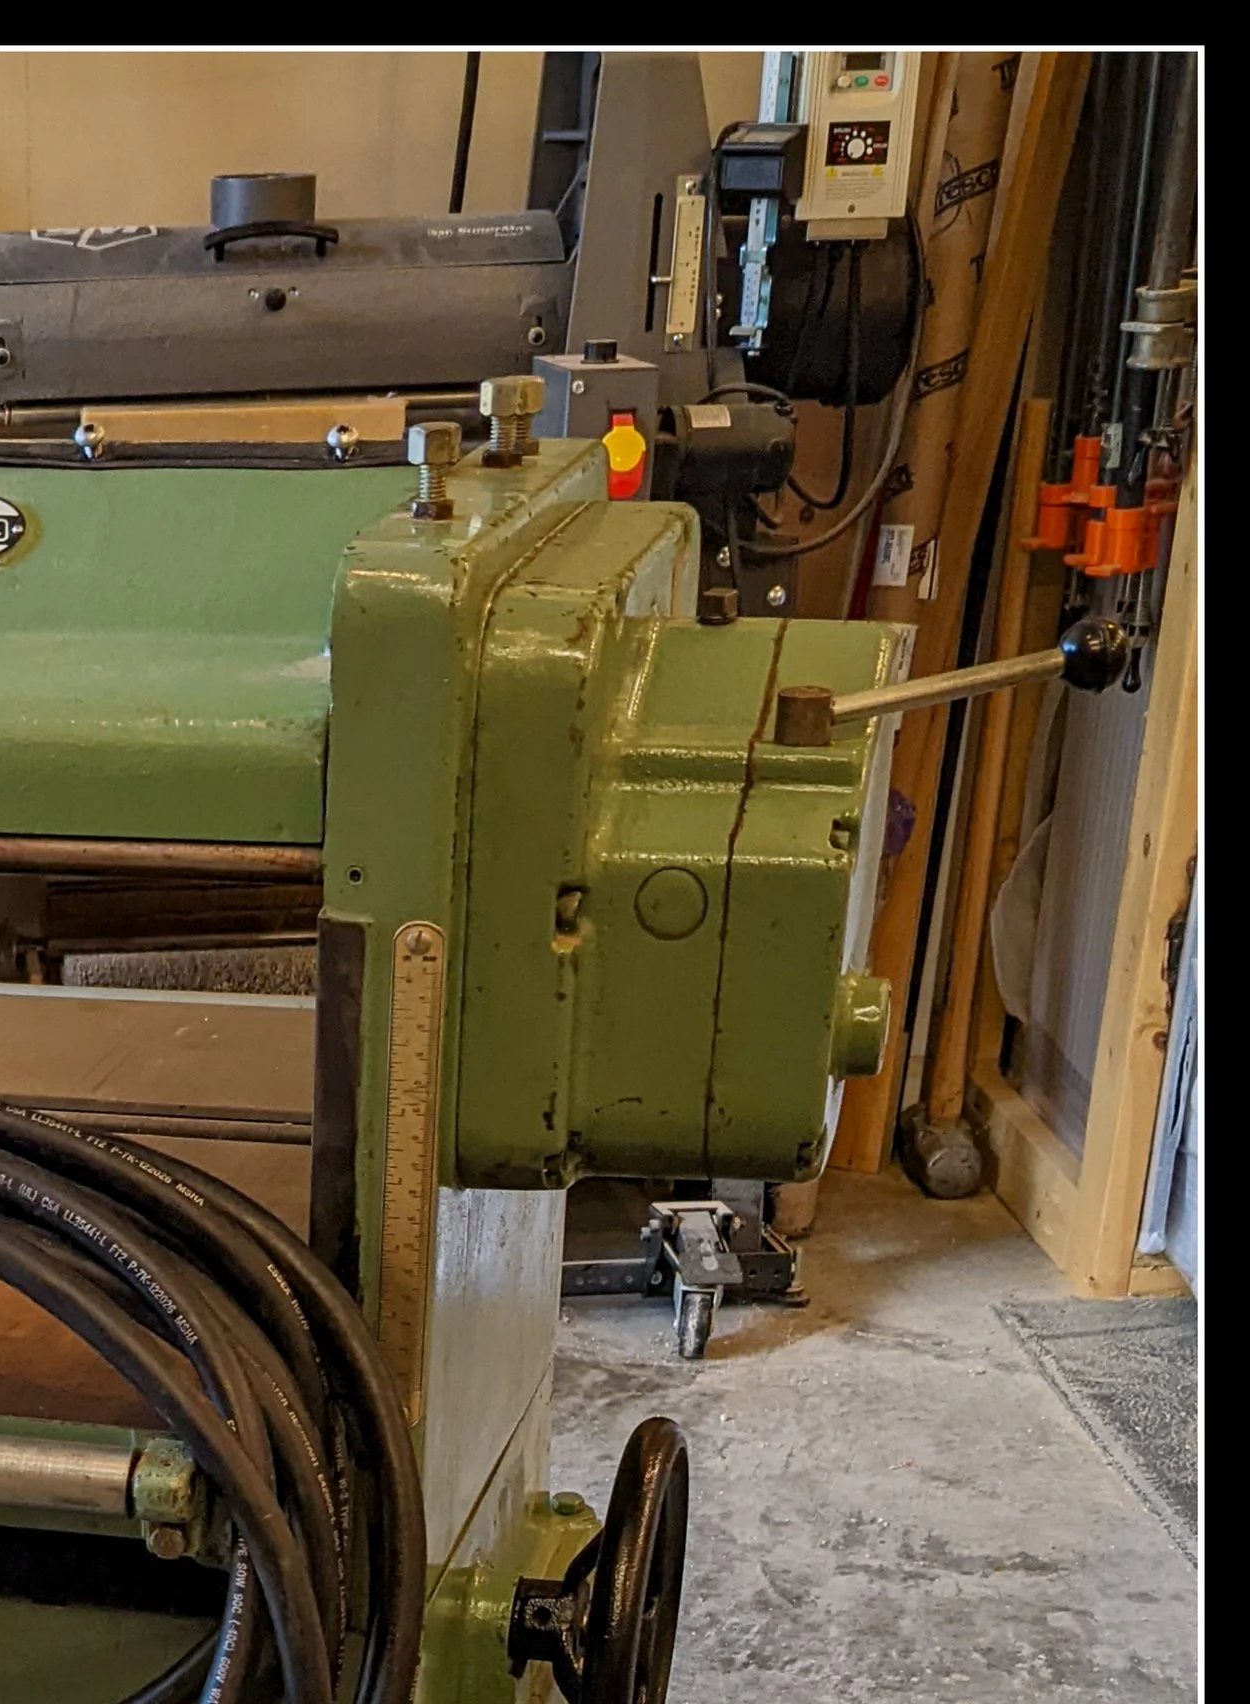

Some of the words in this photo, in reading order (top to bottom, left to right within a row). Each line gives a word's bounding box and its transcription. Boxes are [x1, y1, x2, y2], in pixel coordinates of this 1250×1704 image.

[18, 1182, 38, 1203] (UL)
[41, 1196, 60, 1215] CSA
[63, 1209, 108, 1247] LL35441-L
[108, 1243, 128, 1263] FT2
[127, 1260, 177, 1314] P-7K-122026
[174, 1314, 199, 1345] MSHA
[235, 1562, 248, 1588] SOW
